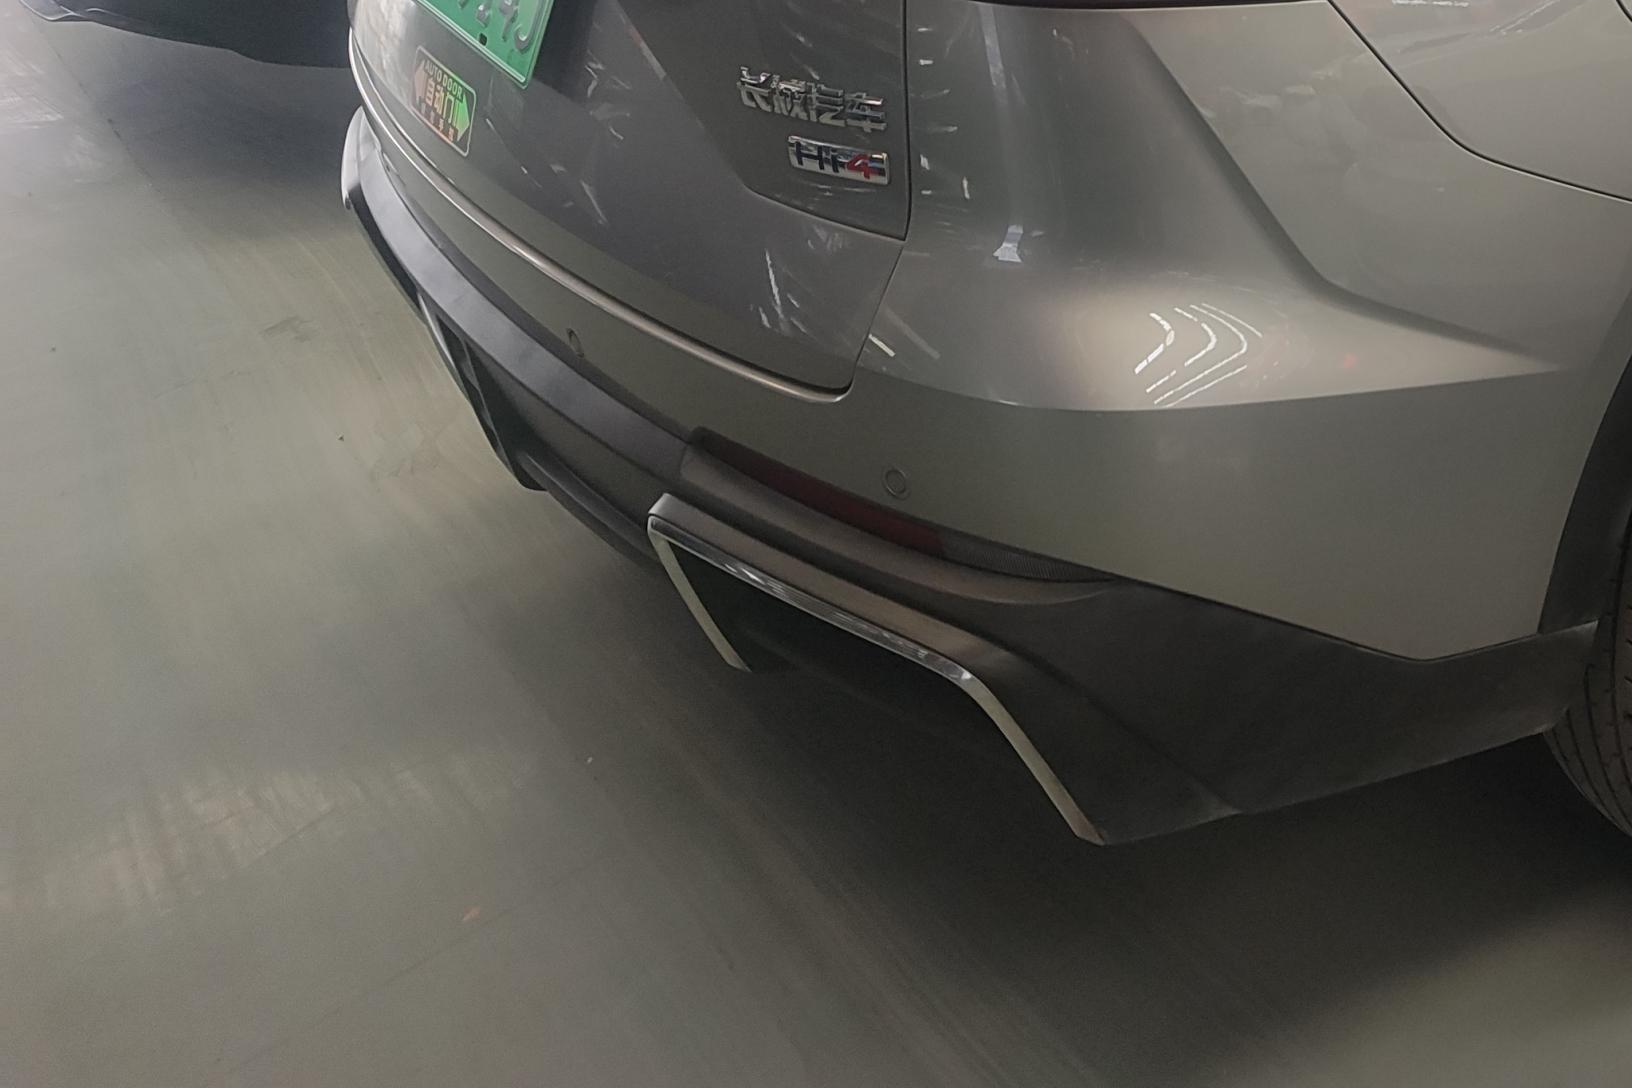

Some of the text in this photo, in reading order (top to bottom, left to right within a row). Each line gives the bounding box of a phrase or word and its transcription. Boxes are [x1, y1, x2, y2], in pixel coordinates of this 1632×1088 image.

[424, 59, 463, 102] AUTO DOOR
[425, 78, 456, 124] 自动门
